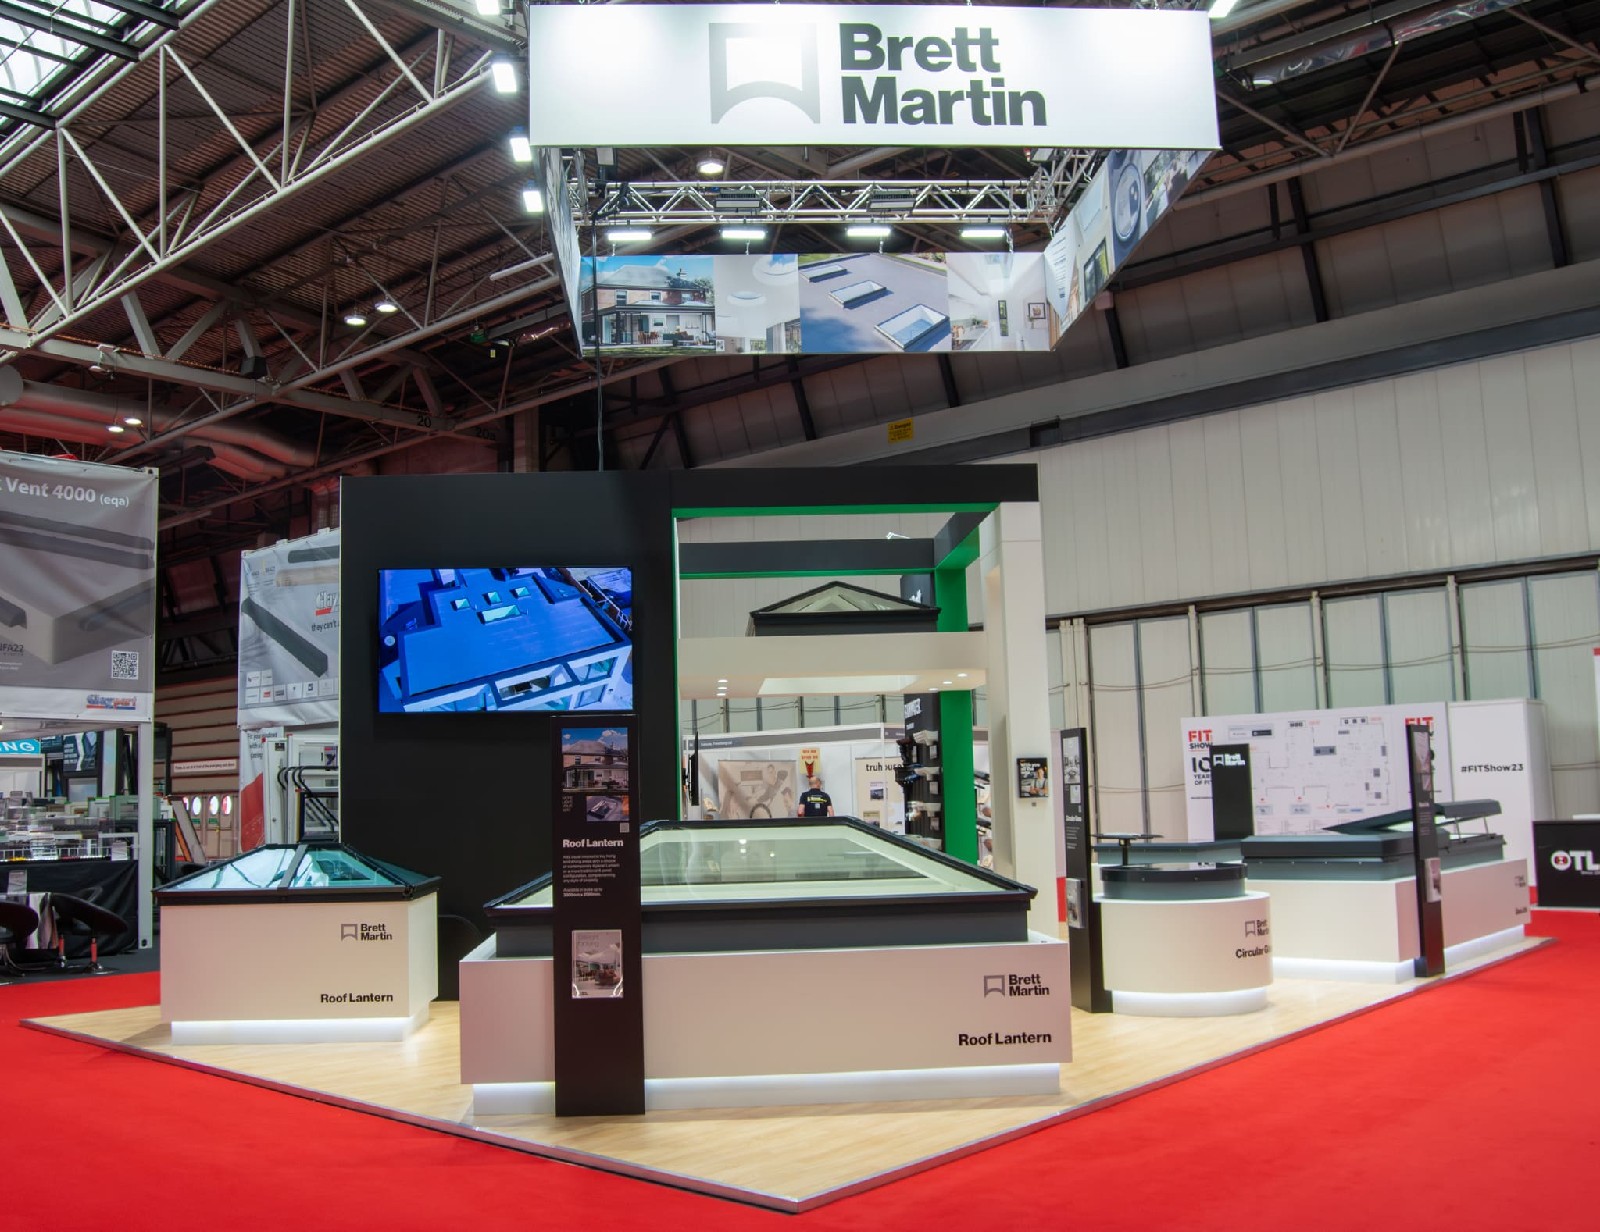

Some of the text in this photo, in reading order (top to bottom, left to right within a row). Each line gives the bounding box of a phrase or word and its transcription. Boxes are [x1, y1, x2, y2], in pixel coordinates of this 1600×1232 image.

[839, 23, 1001, 72] Brett
[840, 77, 1047, 126] Martin
[417, 415, 432, 428] 20
[5, 477, 129, 507] Vent 4000 (eqa)
[1188, 730, 1212, 743] FIT
[0, 741, 35, 752] NG
[1189, 742, 1213, 750] SHOW
[1461, 764, 1524, 772] #FITShow23
[563, 839, 624, 848] Roof Lantern
[361, 924, 386, 932] Brett
[360, 932, 393, 941] Martin
[1235, 947, 1264, 959] Circular
[1008, 974, 1041, 985] Brett
[1009, 985, 1050, 996] Martin
[320, 993, 394, 1003] Roof Lantern
[958, 1032, 1052, 1046] Roof Lantern
